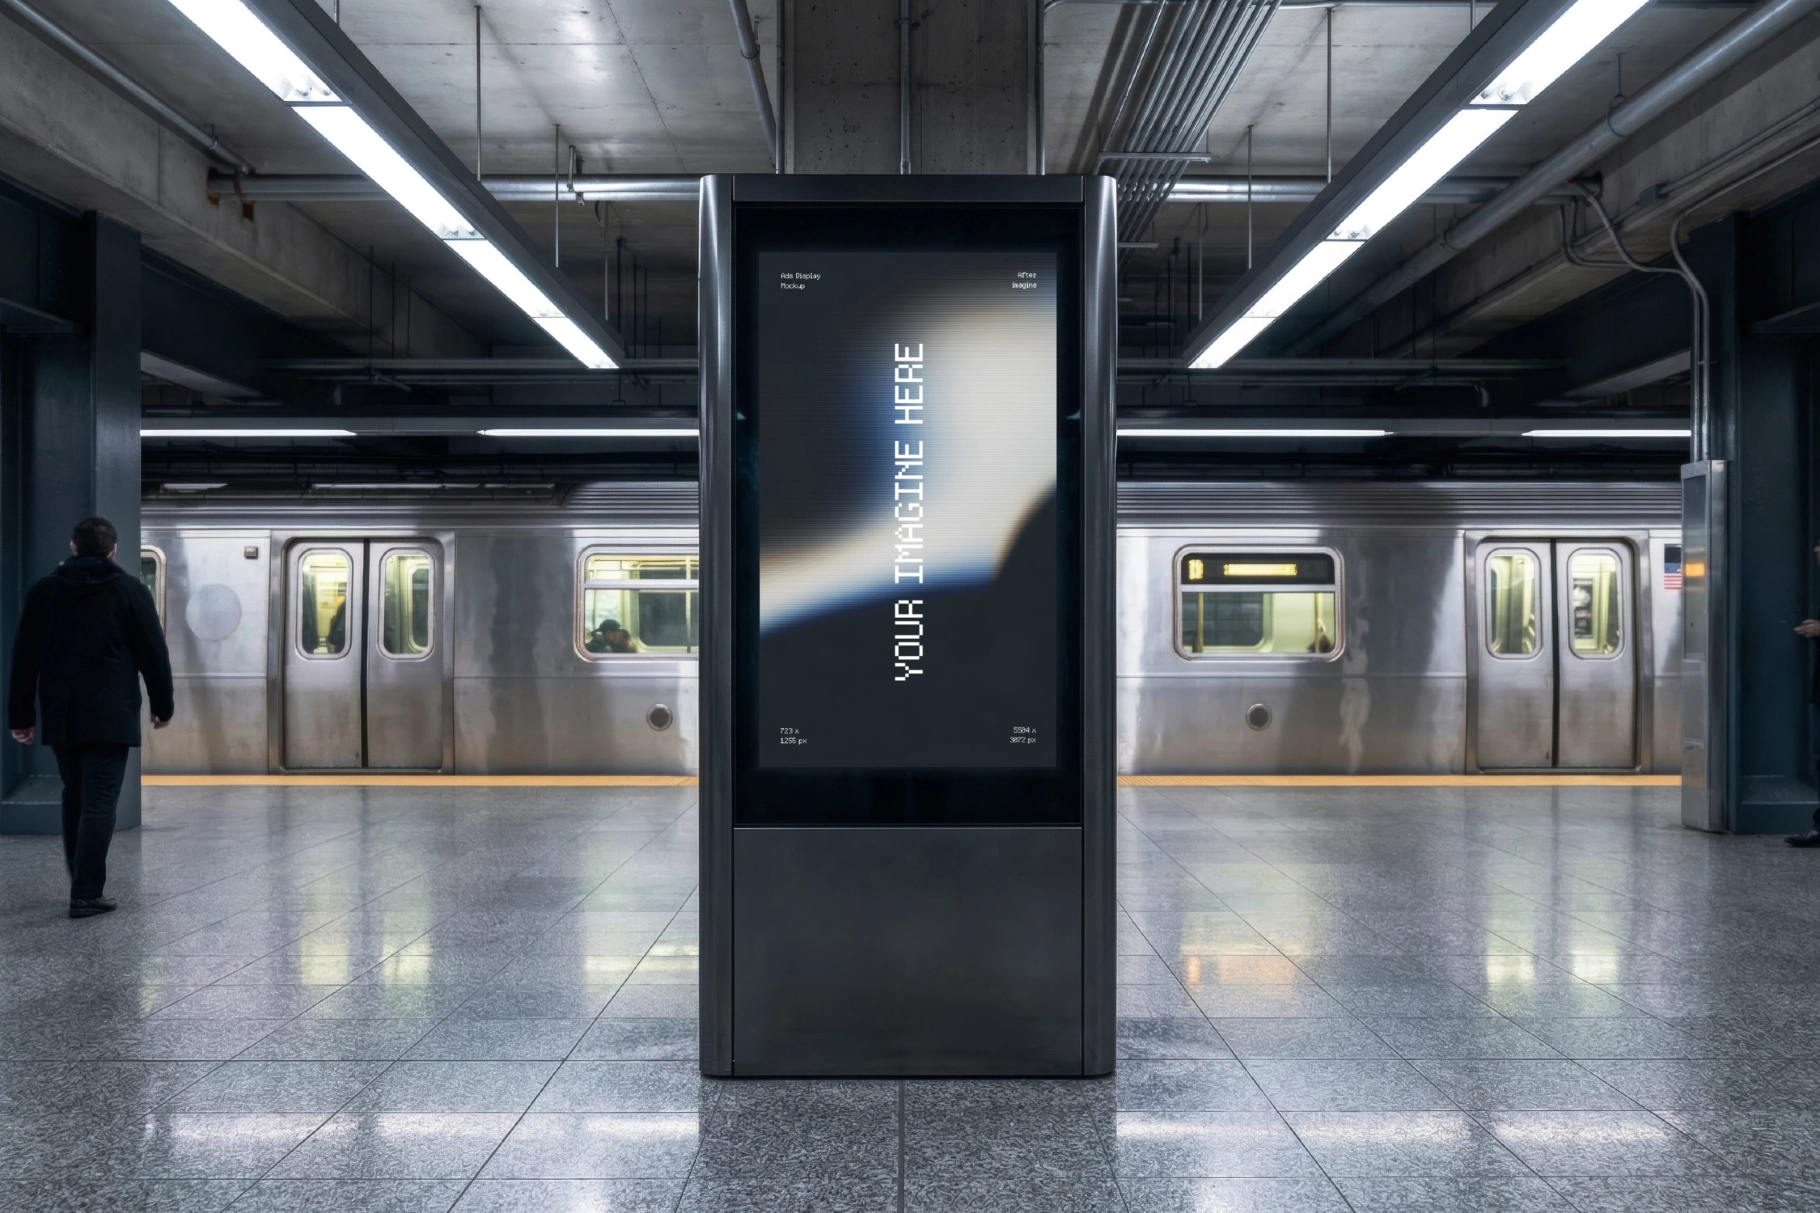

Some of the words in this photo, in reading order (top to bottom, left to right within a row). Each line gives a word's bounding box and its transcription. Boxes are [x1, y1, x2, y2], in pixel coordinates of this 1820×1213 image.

[795, 272, 821, 281] Display
[780, 282, 806, 290] Mockup
[894, 343, 924, 424] HERE
[894, 440, 924, 584] IMAGINE
[894, 599, 924, 681] YOUR
[780, 727, 794, 735] 723
[797, 738, 808, 746] px
[1027, 737, 1037, 745] px
